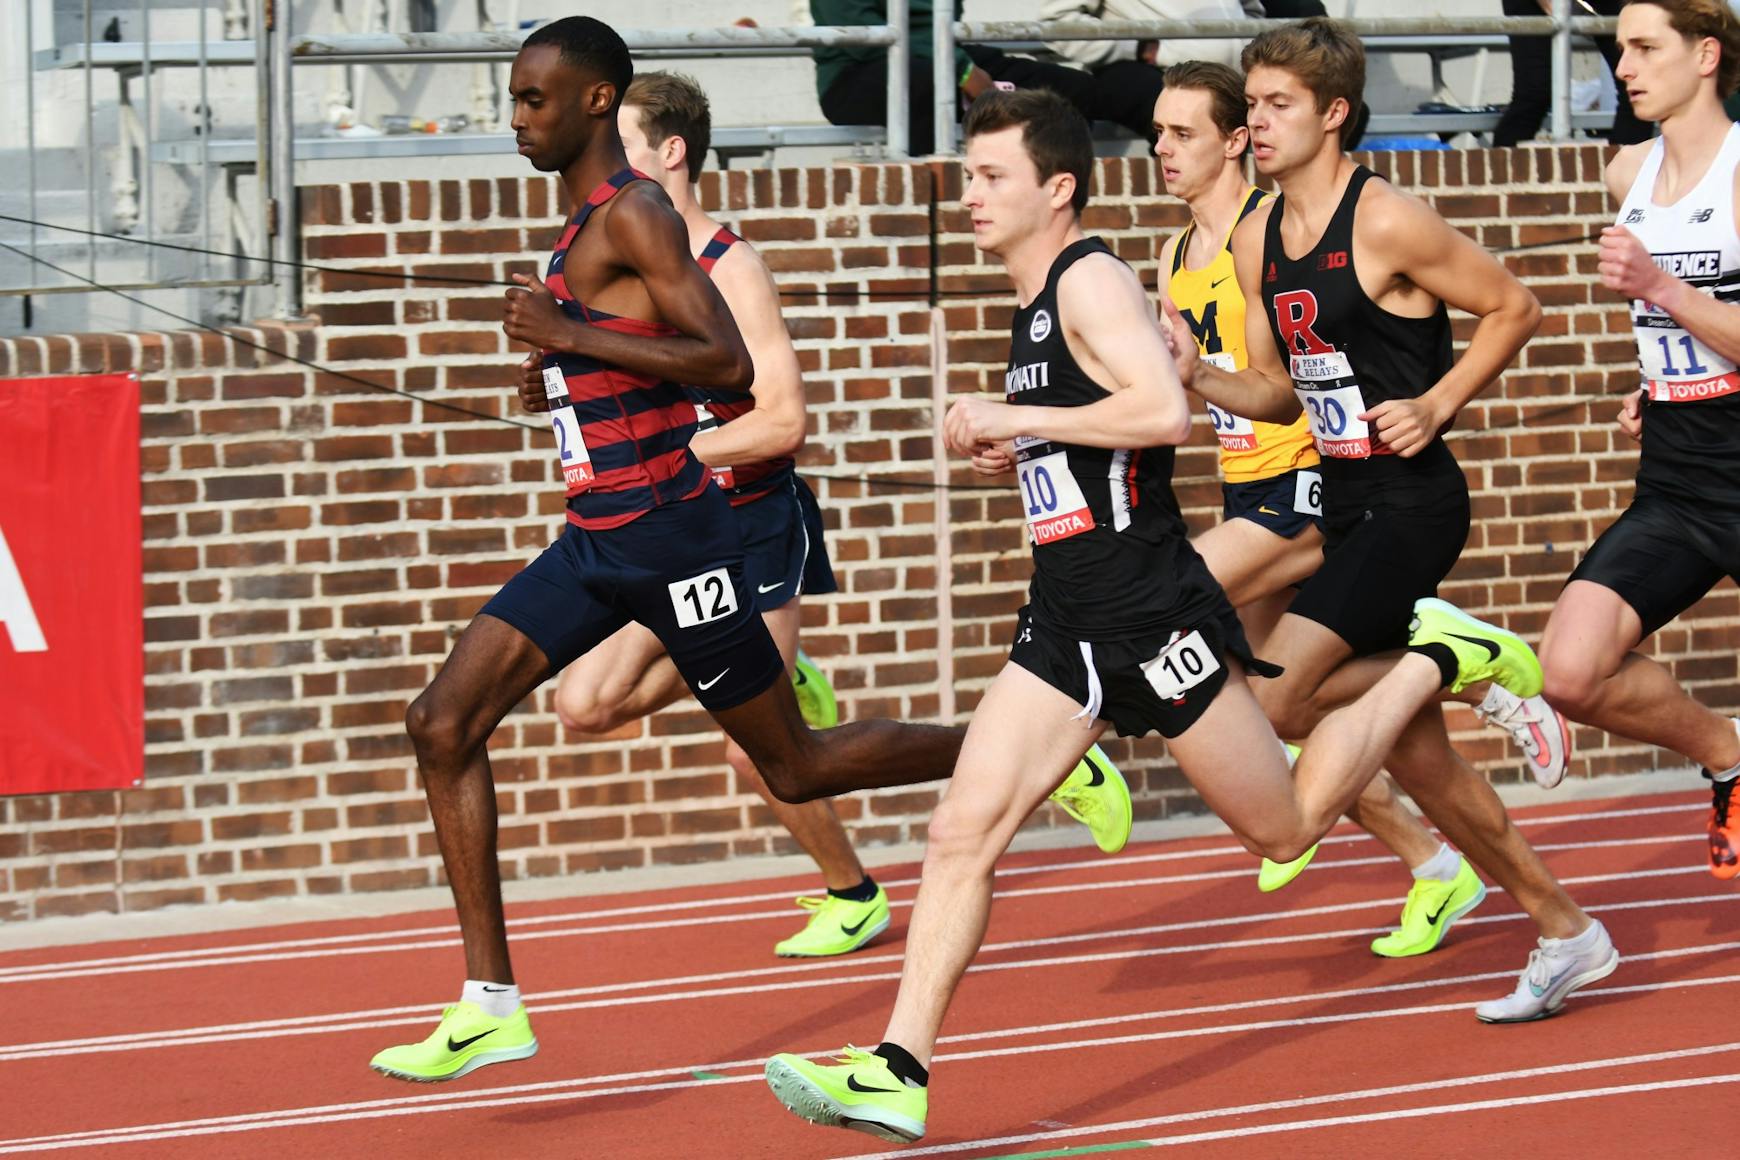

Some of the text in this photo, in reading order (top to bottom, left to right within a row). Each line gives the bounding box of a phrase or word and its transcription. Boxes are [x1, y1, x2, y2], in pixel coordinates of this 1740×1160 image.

[1652, 252, 1719, 278] DENCE
[1178, 300, 1222, 354] M
[1274, 289, 1336, 356] R
[1302, 357, 1327, 368] PENN
[1304, 365, 1339, 377] RELAYS
[1658, 335, 1708, 376] 11
[1669, 378, 1731, 398] TOYOTA
[1306, 396, 1347, 436] 30
[1219, 437, 1250, 449] TOYOTA
[1323, 442, 1364, 455] TOYOTA
[1022, 465, 1058, 516] 10
[1036, 515, 1086, 540] TOYOTA
[684, 576, 730, 621] 12
[1162, 647, 1203, 685] 10
